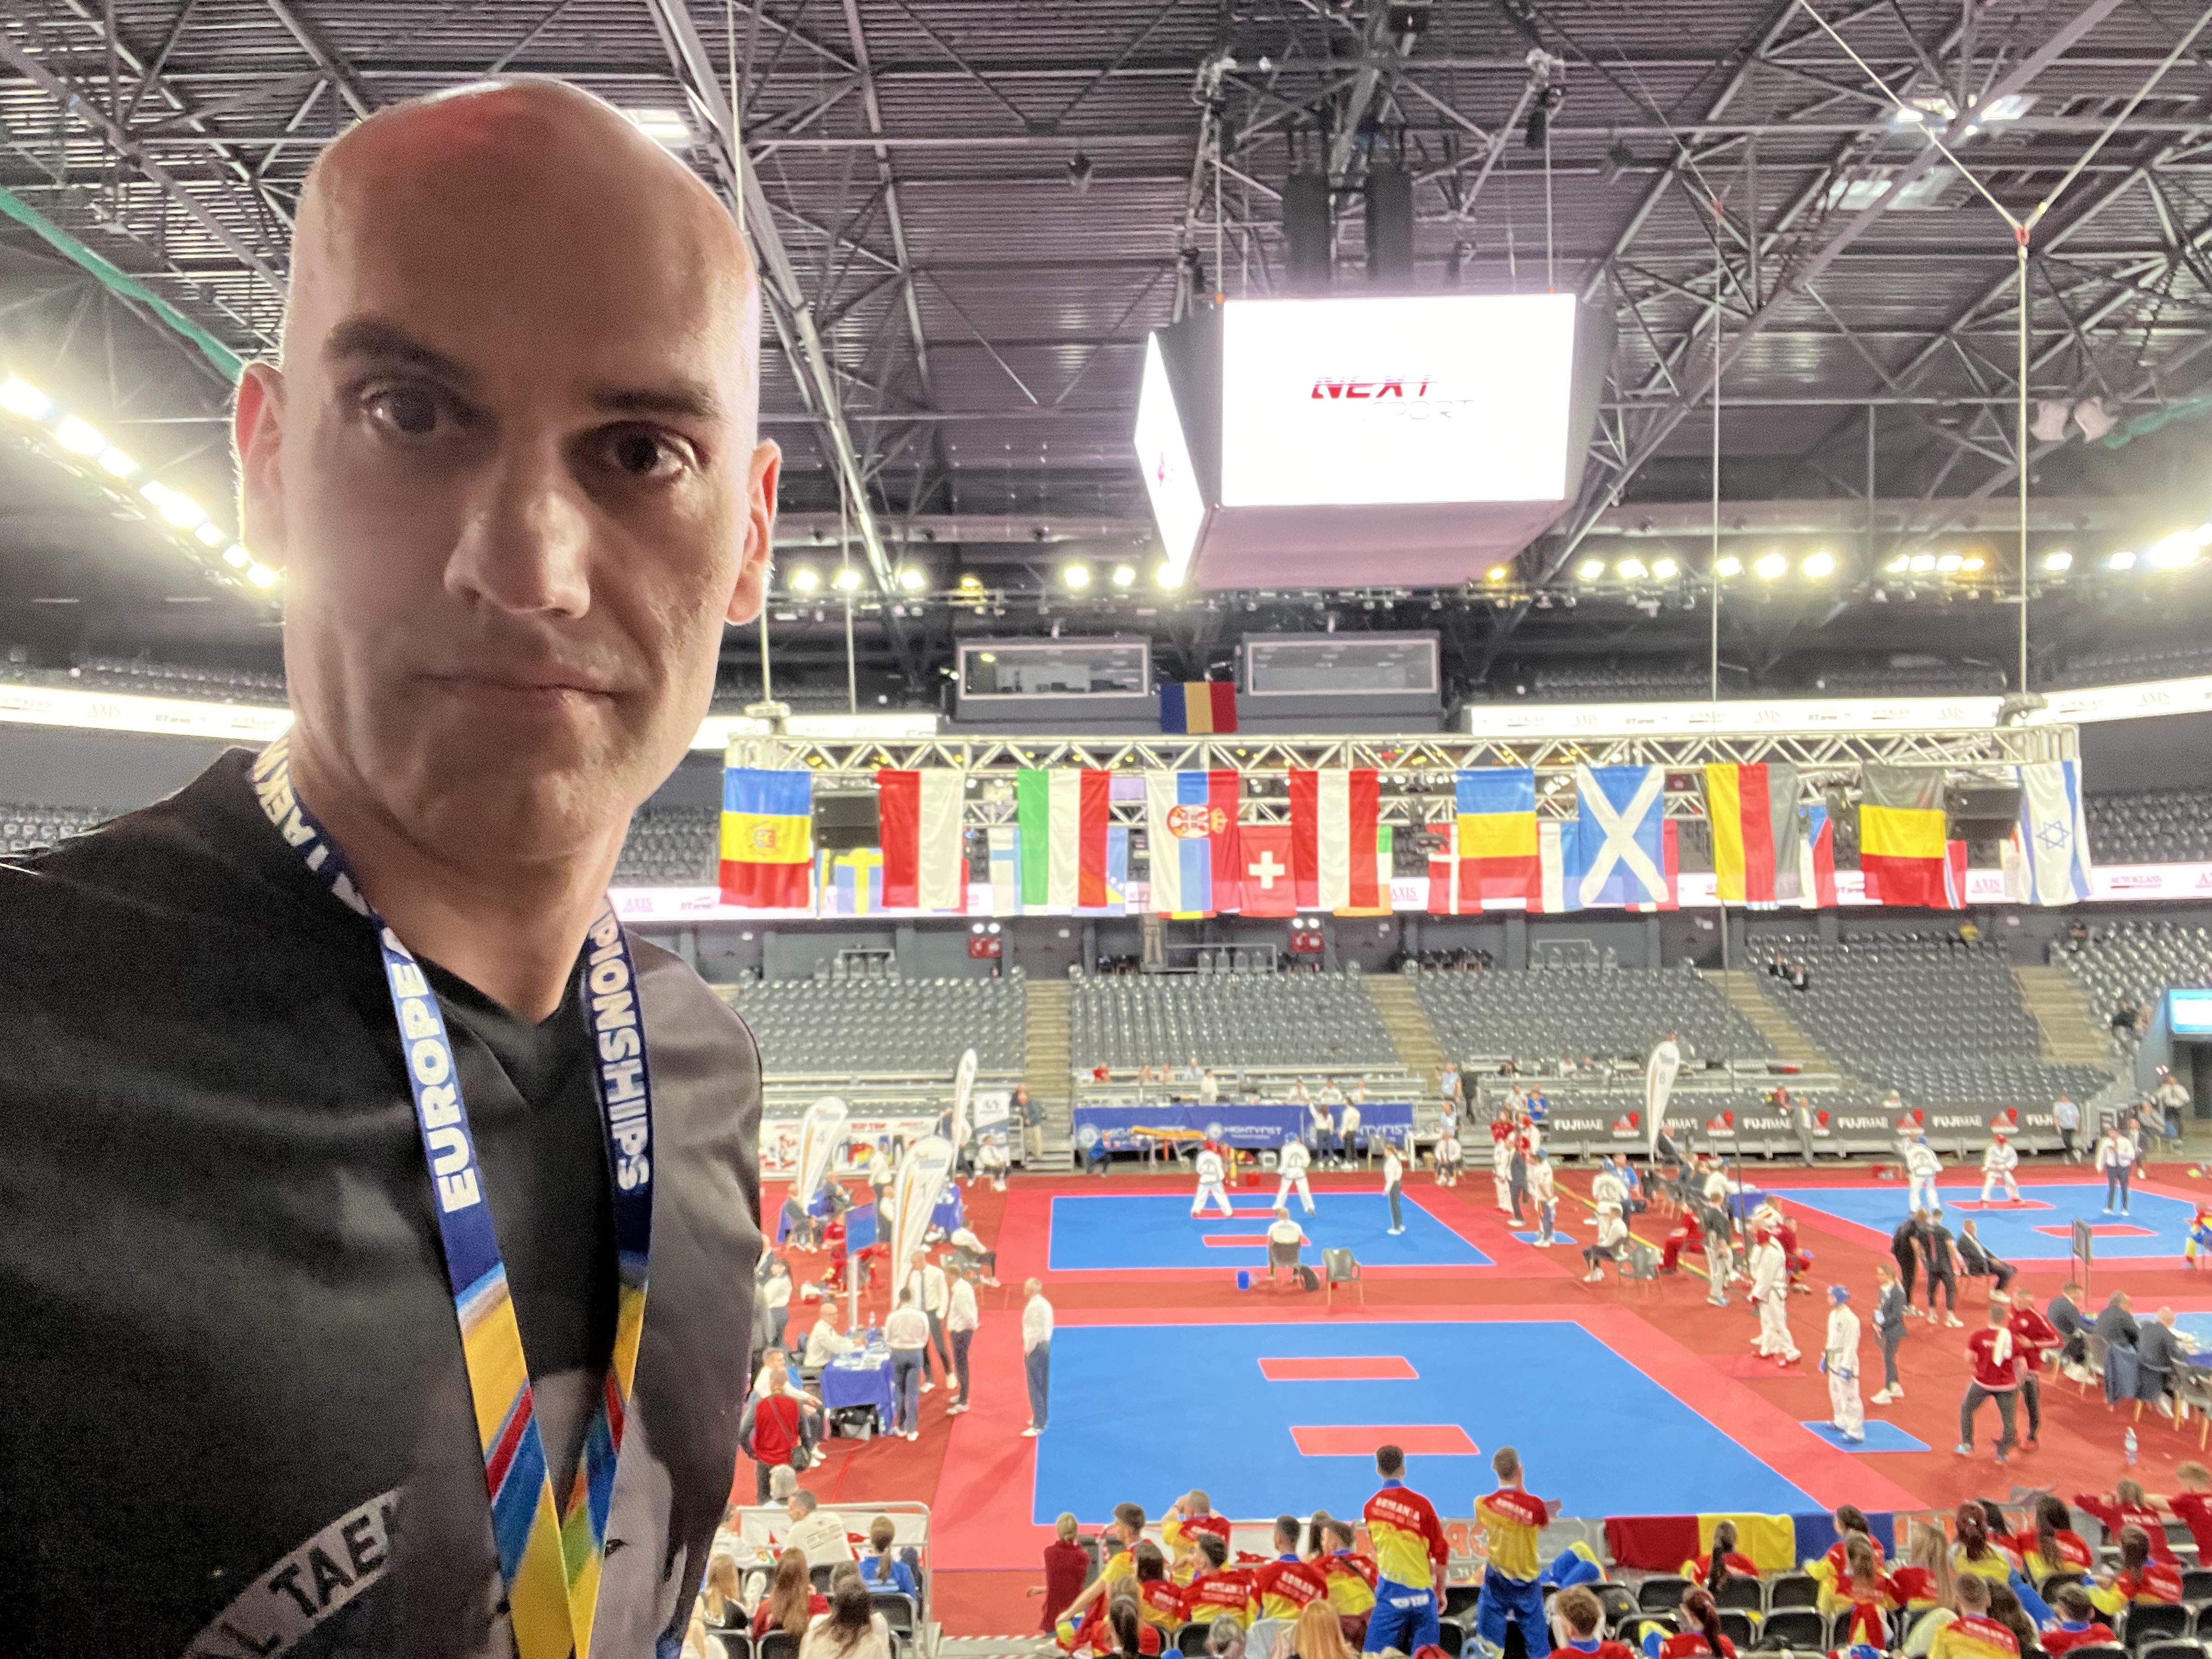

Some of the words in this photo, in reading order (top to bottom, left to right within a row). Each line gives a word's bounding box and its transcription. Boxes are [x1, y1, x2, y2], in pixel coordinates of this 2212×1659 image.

[1311, 375, 1435, 399] NEXT
[625, 898, 652, 909] AXIS
[589, 902, 650, 1190] PIONSHIPS
[2027, 1114, 2053, 1126] FUJI
